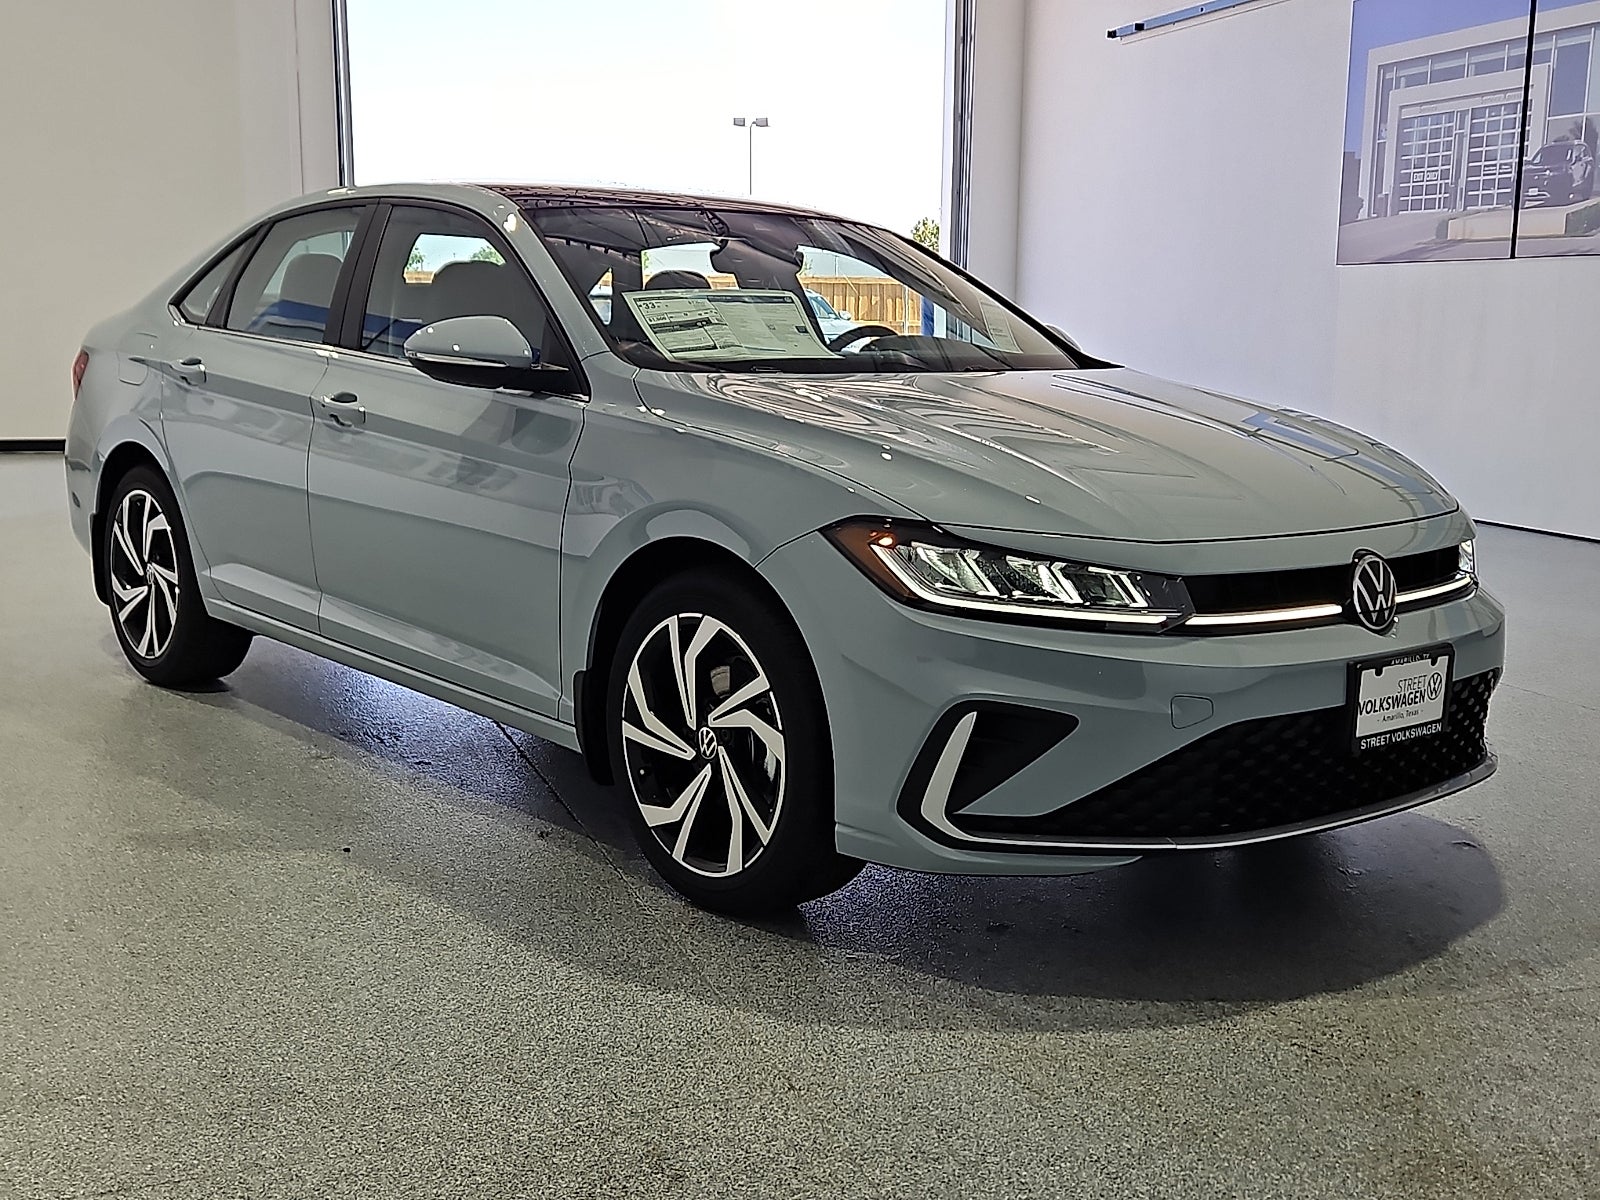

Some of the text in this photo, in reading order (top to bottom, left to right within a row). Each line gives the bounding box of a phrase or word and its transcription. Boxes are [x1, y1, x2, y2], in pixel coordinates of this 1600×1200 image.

[1353, 555, 1397, 629] VW
[1398, 674, 1427, 694] STREET
[1358, 689, 1427, 716] VOLKSWAGEN
[1406, 709, 1419, 718] Texas
[1361, 722, 1442, 750] STREET VOLKSWAGEN
